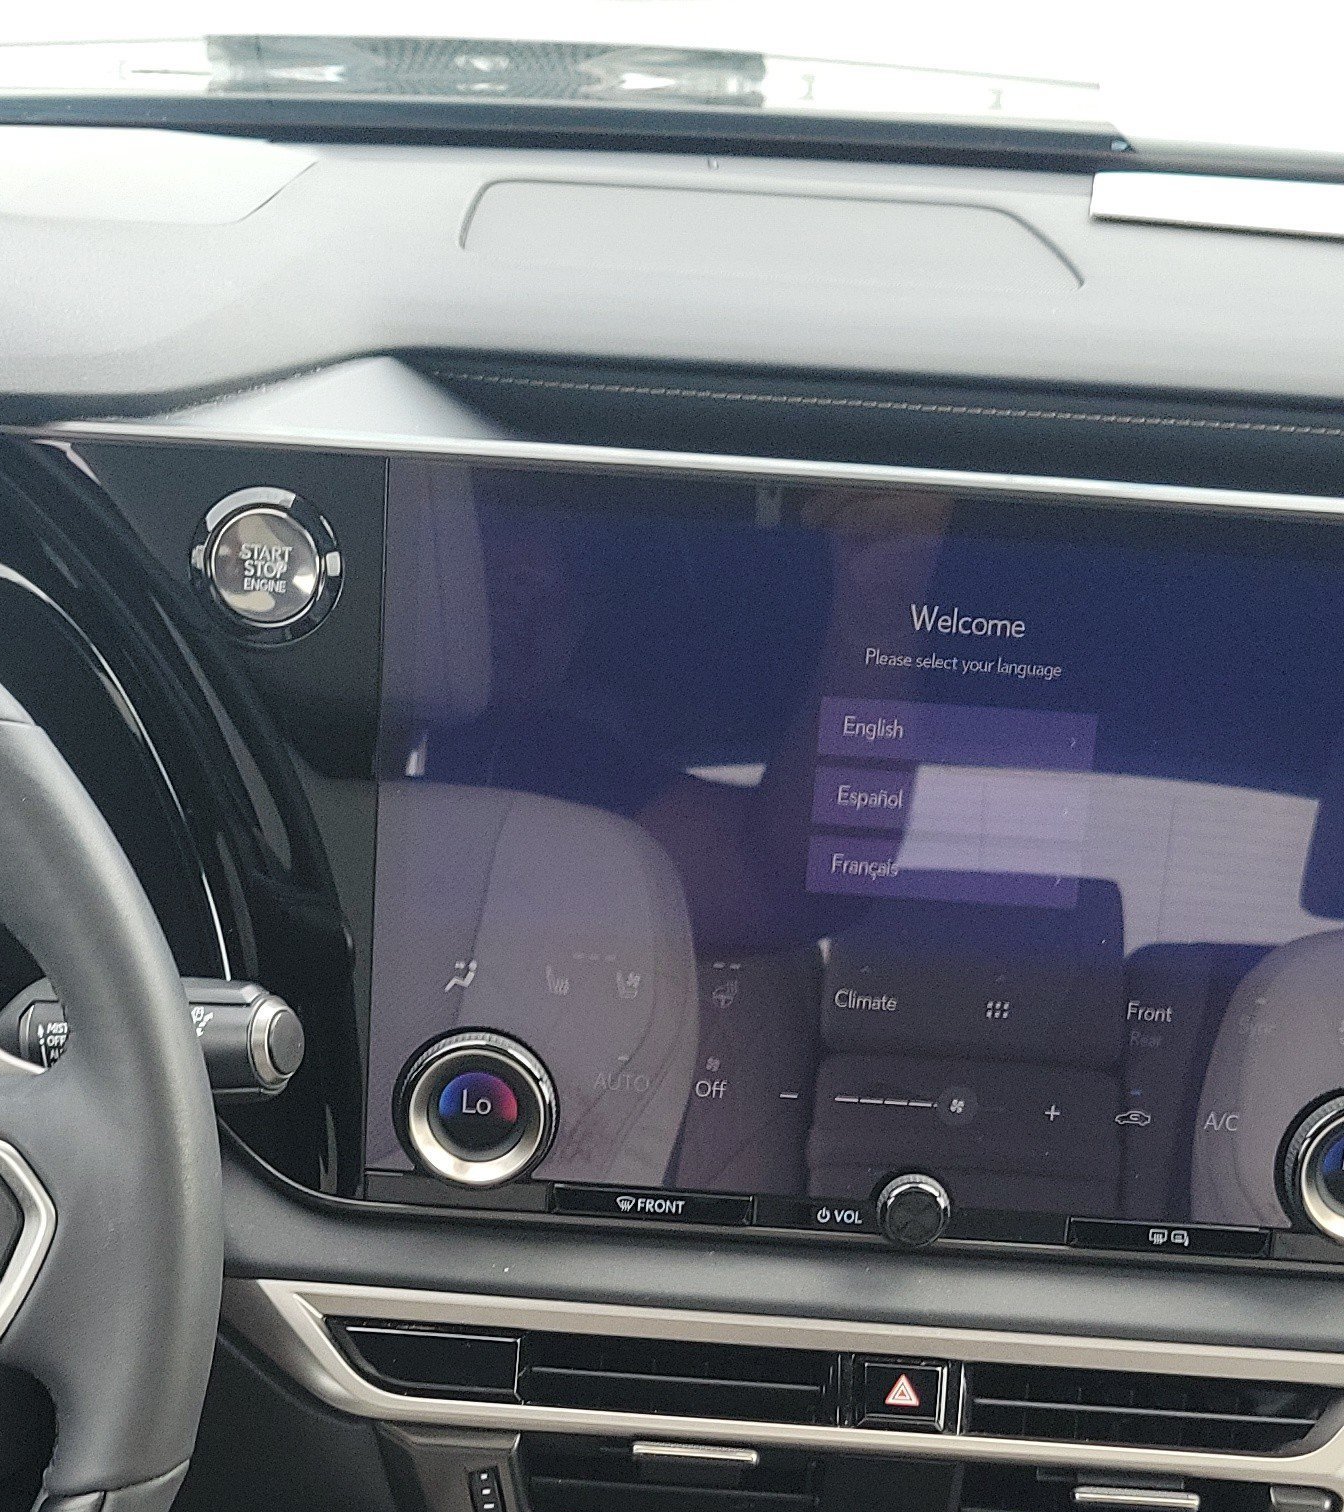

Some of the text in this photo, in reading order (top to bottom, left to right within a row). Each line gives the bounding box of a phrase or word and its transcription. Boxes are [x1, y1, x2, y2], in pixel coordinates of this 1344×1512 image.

[241, 544, 293, 562] START
[244, 560, 287, 578] STOP
[244, 579, 286, 593] ENGINE
[910, 603, 1026, 638] Welcome
[865, 648, 1062, 681] Please select your language
[842, 715, 903, 740] English
[837, 785, 903, 811] Español
[830, 853, 900, 880] Français
[834, 988, 898, 1012] Climate
[1126, 1000, 1173, 1023] Front
[46, 1022, 68, 1034] MIST
[694, 1078, 728, 1100] Off
[459, 1088, 492, 1117] Lo
[1203, 1111, 1239, 1132] A/C
[637, 1199, 686, 1215] FRONT
[834, 1209, 863, 1225] VOL
